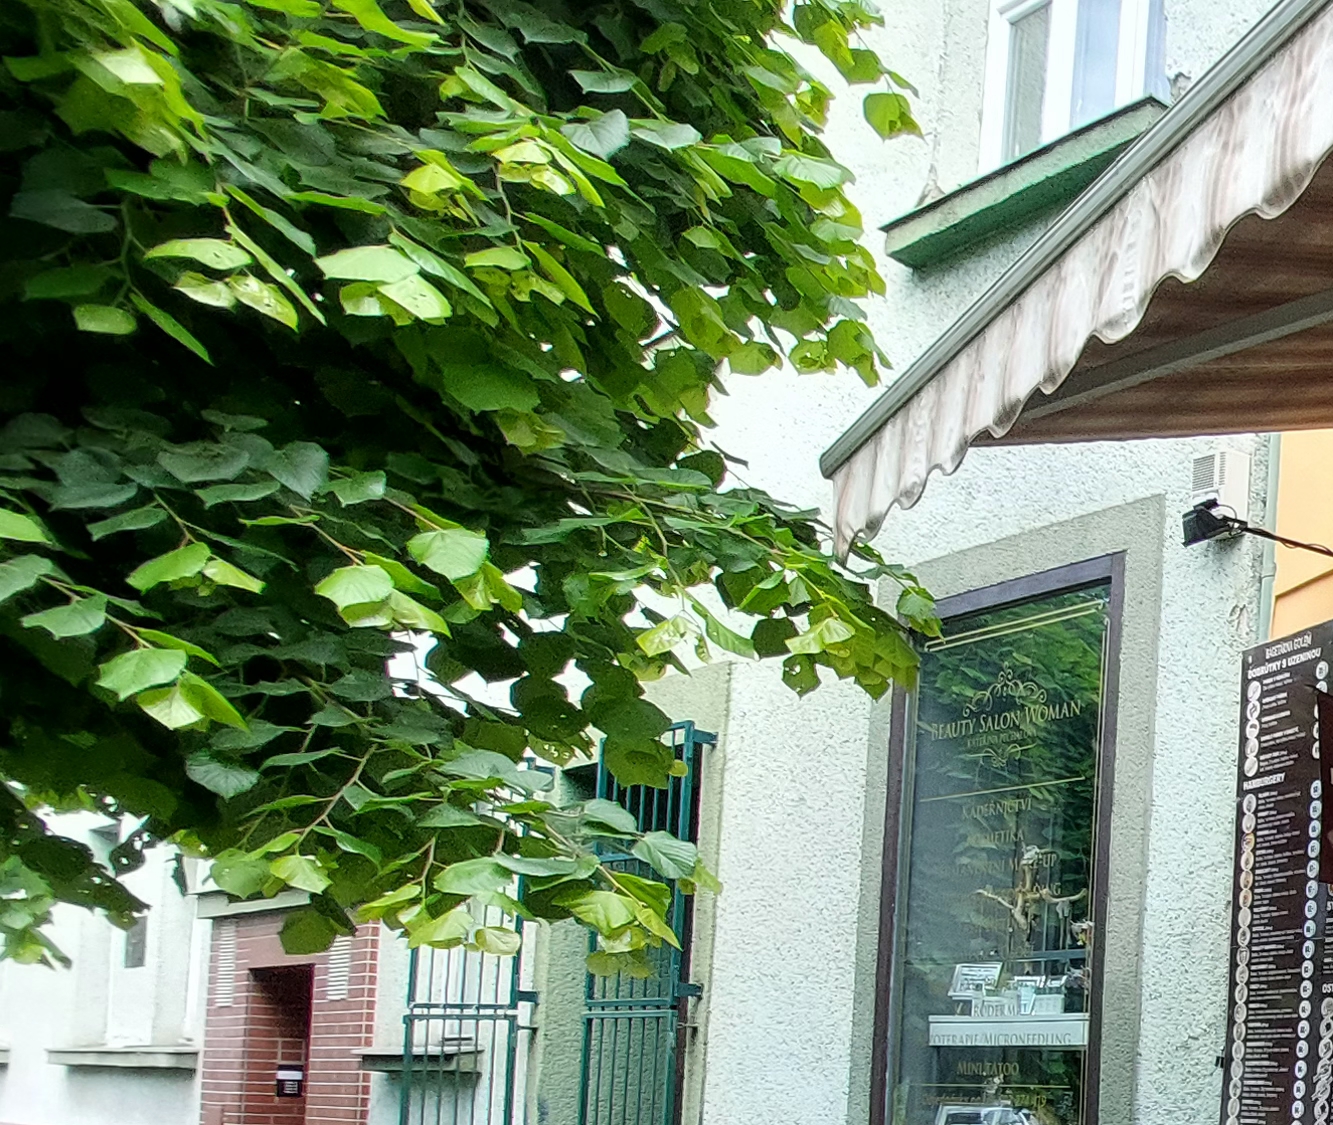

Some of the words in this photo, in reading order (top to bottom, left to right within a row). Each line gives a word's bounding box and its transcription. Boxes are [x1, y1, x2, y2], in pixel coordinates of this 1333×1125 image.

[931, 719, 976, 740] BEAUTY
[979, 711, 1020, 732] SALON
[1025, 700, 1081, 724] WOMAN
